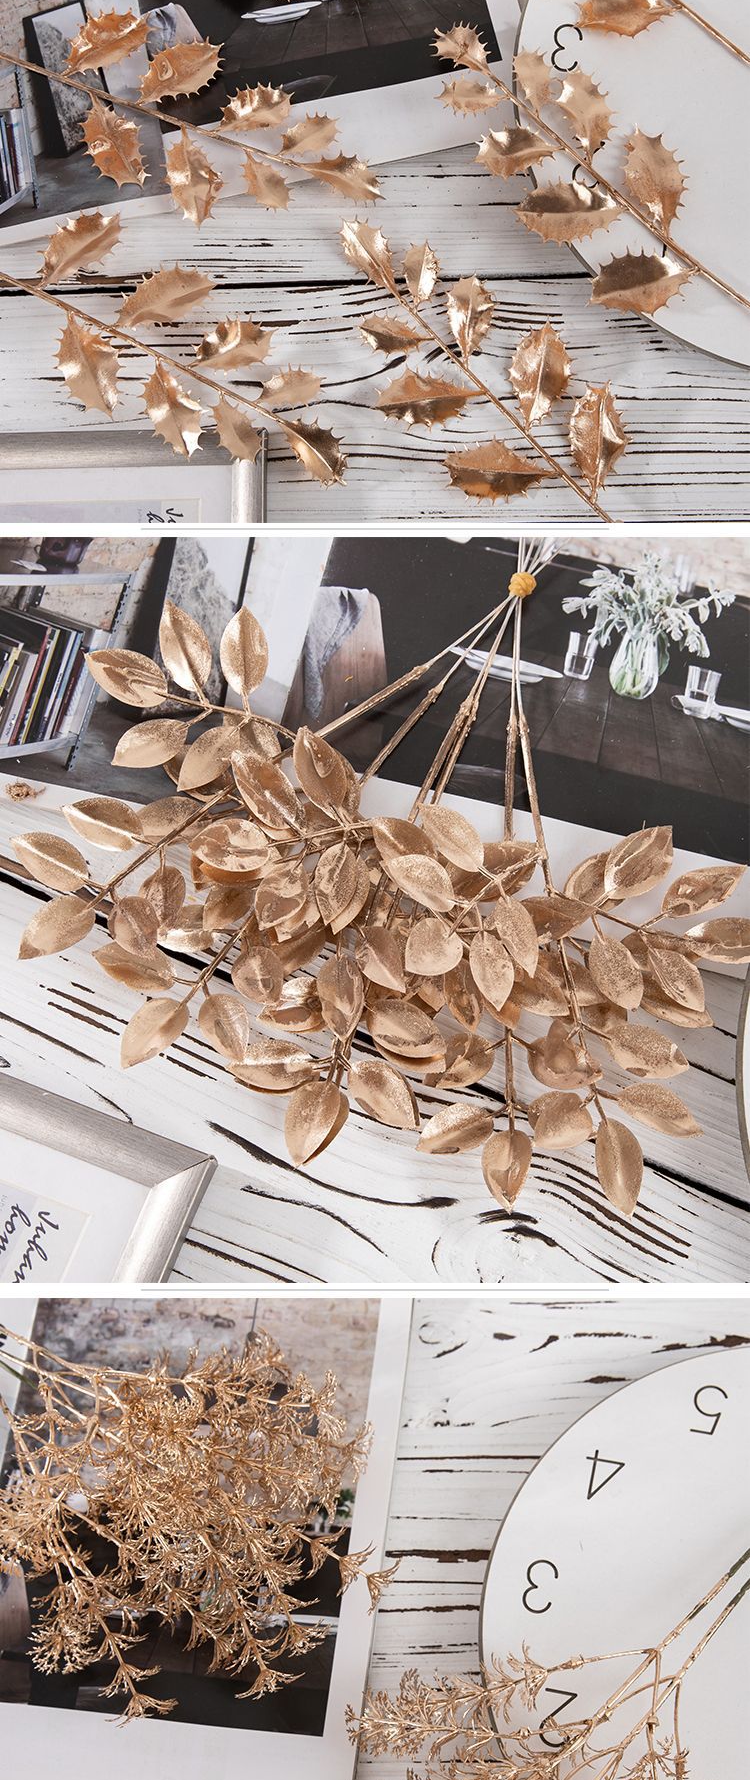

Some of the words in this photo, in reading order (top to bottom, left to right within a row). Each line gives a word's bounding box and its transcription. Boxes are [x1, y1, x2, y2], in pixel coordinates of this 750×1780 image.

[551, 23, 583, 72] 3
[690, 1385, 728, 1436] 5
[586, 1449, 625, 1500] 4
[522, 1559, 558, 1614] 3
